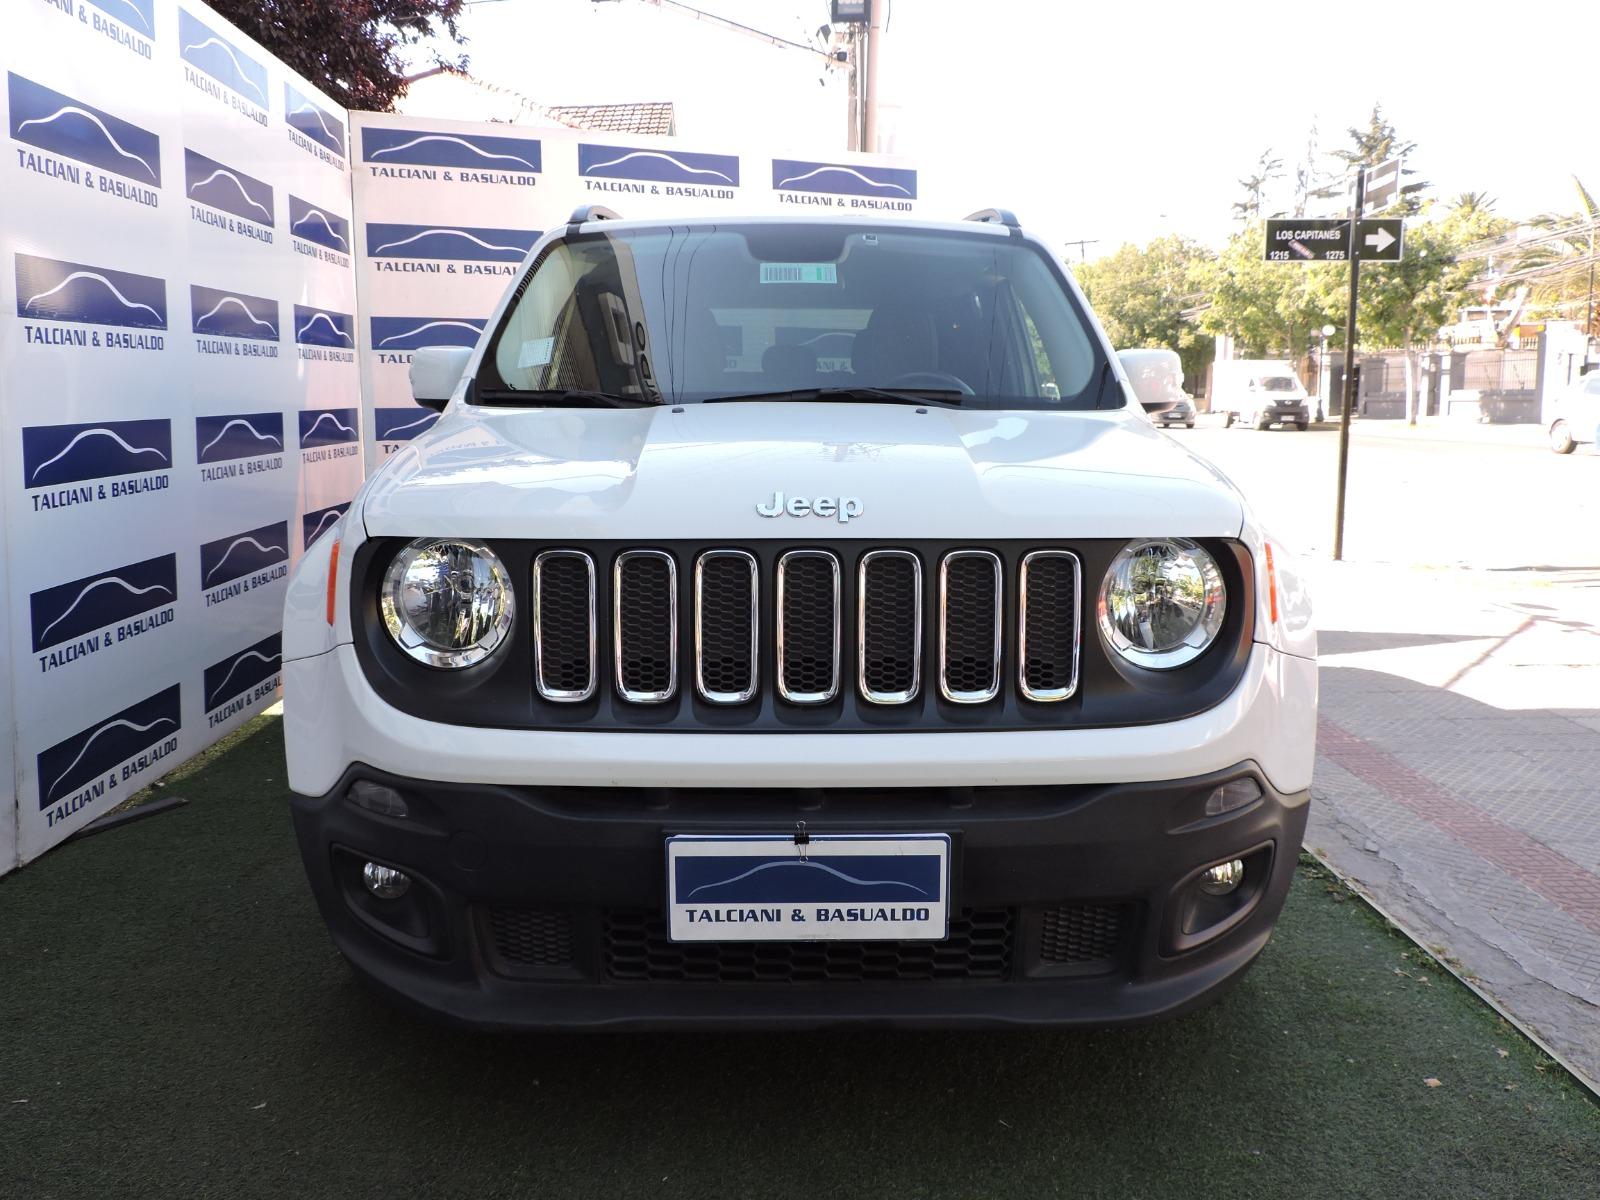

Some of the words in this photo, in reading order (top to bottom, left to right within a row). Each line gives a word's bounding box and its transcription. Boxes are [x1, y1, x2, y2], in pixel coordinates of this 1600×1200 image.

[79, 5, 88, 24] &
[93, 12, 151, 60] BASUALDO
[184, 67, 220, 100] TALCIANI
[224, 92, 228, 104] &
[232, 96, 268, 127] BASUALDO
[17, 149, 80, 184] TALCIANI
[86, 171, 94, 188] &
[100, 176, 158, 208] BASUALDO
[370, 166, 436, 180] TALCIANI
[444, 172, 453, 180] &
[460, 172, 536, 186] BASUALDO
[585, 180, 645, 194] TALCIANI
[651, 185, 660, 194] &
[666, 186, 734, 200] BASUALDO
[778, 194, 832, 206] TALCIANI
[838, 198, 845, 207] &
[851, 198, 912, 212] BASUALDO
[191, 206, 226, 230] TALCIANI
[229, 220, 234, 232] &
[238, 222, 272, 244] BASUALDO
[1276, 230, 1294, 240] LOS
[1294, 230, 1341, 240] CAPITANES
[1270, 250, 1290, 260] 1215
[1325, 250, 1345, 260] 1275
[374, 261, 440, 273] TALCIANI
[447, 264, 456, 274] &
[24, 326, 86, 346] TALCIANI
[92, 332, 100, 346] &
[106, 332, 164, 350] BASUALDO
[196, 340, 232, 355] TALCIANI
[235, 343, 240, 356] &
[243, 344, 278, 358] BASUALDO
[378, 354, 412, 364] TALC
[201, 464, 236, 482] TALCIANI
[239, 464, 244, 476] &
[248, 458, 282, 474] BASUALDO
[32, 486, 92, 512] TALCIANI
[98, 485, 106, 500] &
[112, 474, 168, 498] BASUALDO
[756, 491, 864, 523] Jeep
[206, 582, 240, 607] TALCIANI
[244, 580, 249, 592] &
[252, 565, 287, 589] BASUALDO
[40, 636, 99, 672] TALCIANI
[104, 632, 112, 647] &
[118, 608, 174, 642] BASUALDO
[209, 698, 244, 728] TALCIANI
[246, 694, 252, 706] &
[255, 676, 282, 701] BASUAL
[46, 780, 104, 828] TALCIANI
[110, 774, 118, 789] &
[122, 738, 177, 780] BASUALDO
[686, 909, 781, 922] TALCIANI
[791, 909, 806, 922] &
[816, 908, 929, 922] BASUALDO
